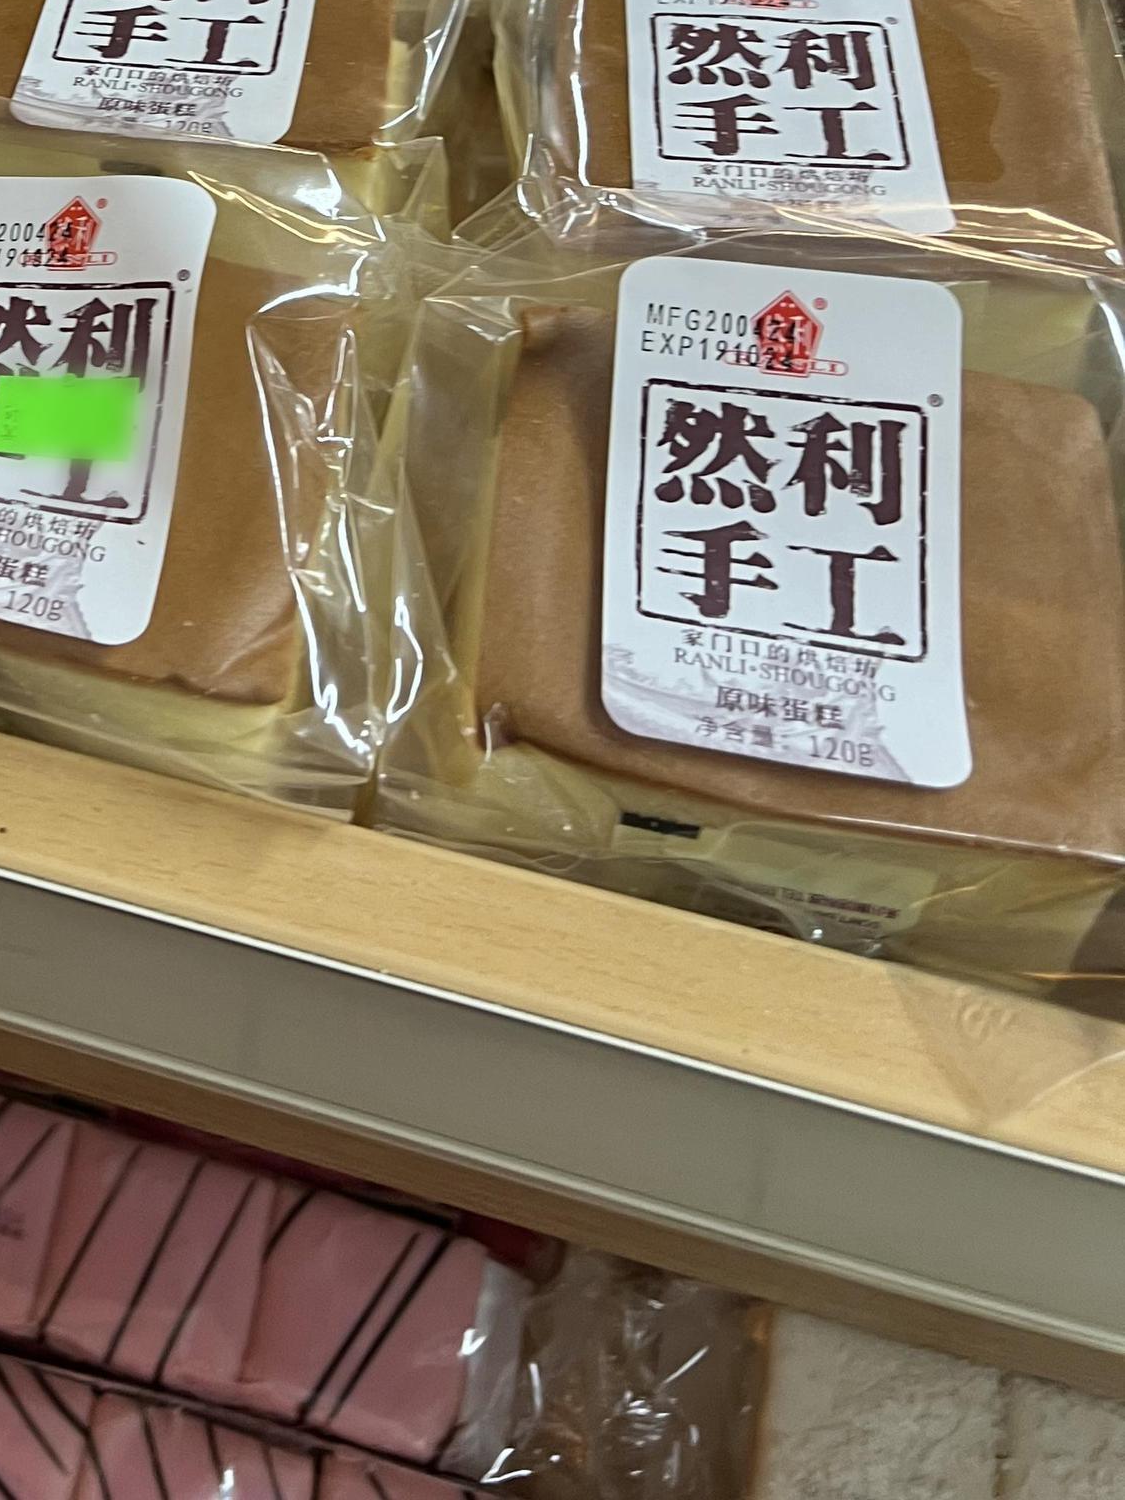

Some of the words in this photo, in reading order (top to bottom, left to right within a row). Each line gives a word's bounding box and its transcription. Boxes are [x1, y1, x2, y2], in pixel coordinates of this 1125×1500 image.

[74, 5, 265, 68] 手工
[666, 22, 876, 91] 然利
[672, 93, 892, 161] 手工
[654, 398, 909, 526] 然利
[4, 590, 65, 622] 120g
[656, 520, 906, 646] 手工
[808, 735, 876, 768] 120g
